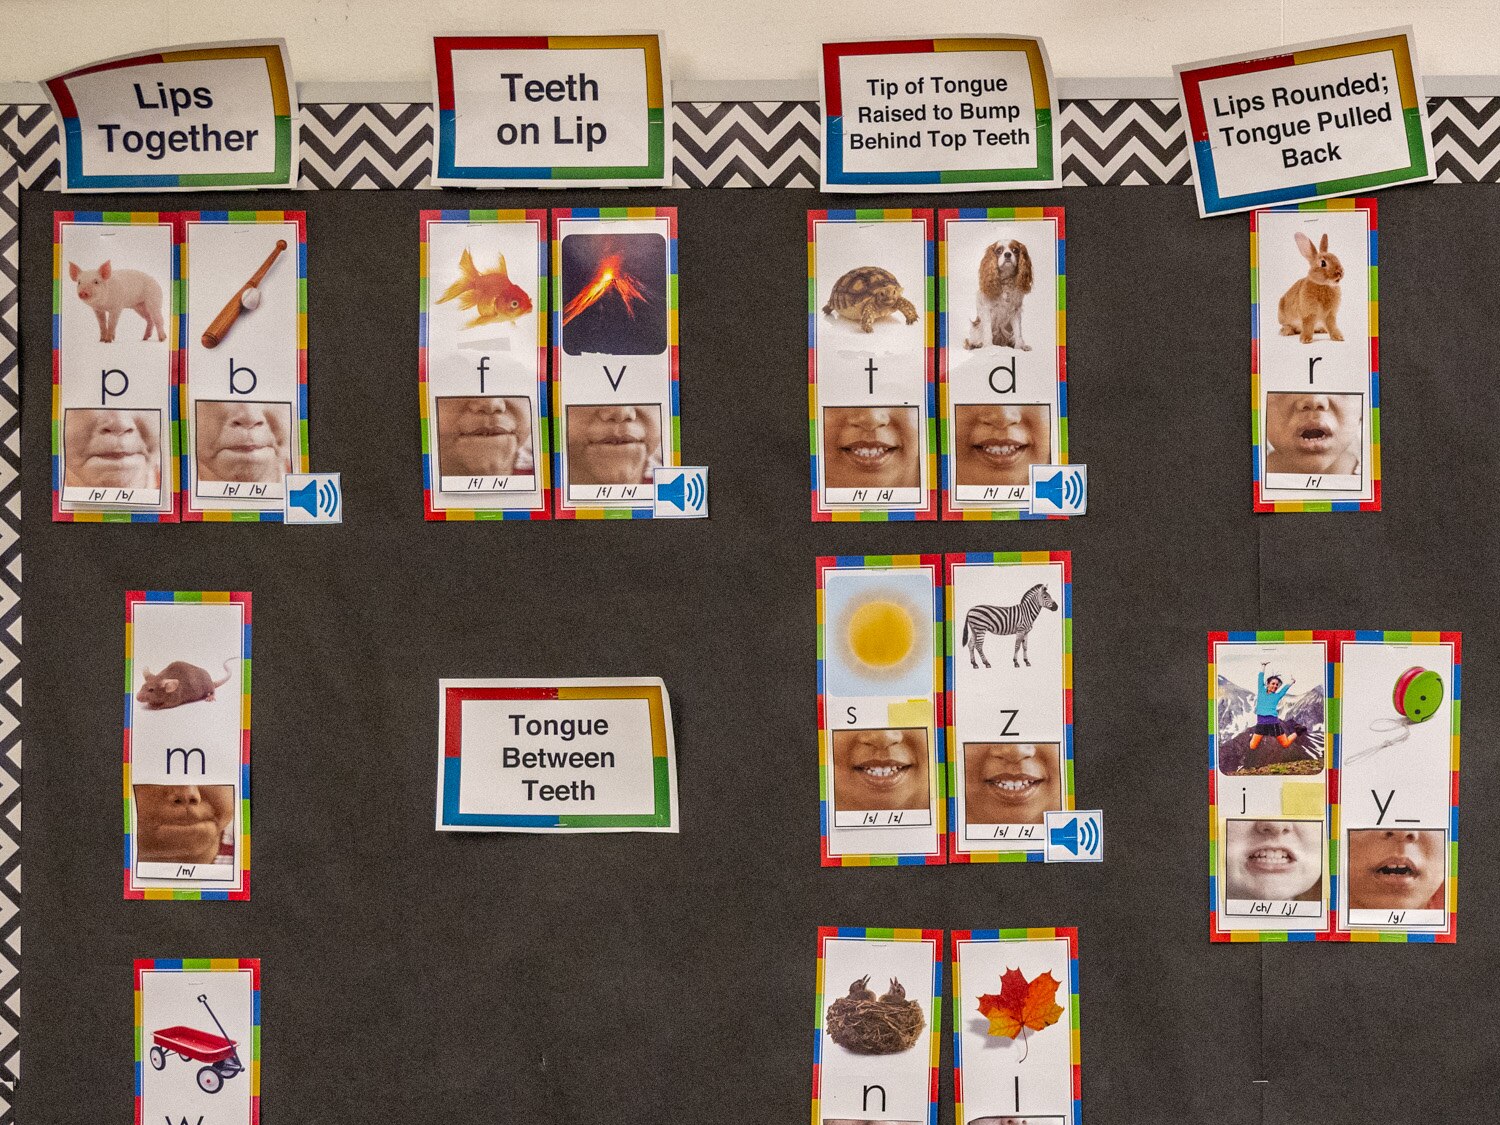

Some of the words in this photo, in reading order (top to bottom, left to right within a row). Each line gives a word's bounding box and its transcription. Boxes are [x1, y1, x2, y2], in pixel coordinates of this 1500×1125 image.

[133, 82, 213, 116] Lips
[501, 73, 598, 102] Teeth
[867, 79, 898, 99] Tip
[905, 77, 924, 94] of
[931, 77, 1007, 97] Tongue
[1213, 95, 1265, 119] Lips
[1272, 72, 1390, 110] Rounded;
[859, 104, 926, 123] Raised
[933, 105, 952, 120] to
[961, 103, 1020, 122] Bump
[1219, 120, 1312, 148] Tongue
[1317, 102, 1391, 131] Pulled
[97, 124, 258, 160] Together
[497, 123, 539, 145] on
[554, 116, 606, 152] Lip
[851, 131, 921, 149] Behind
[927, 131, 966, 151] Top
[973, 128, 1029, 145] Teeth
[1282, 142, 1342, 168] Back
[230, 358, 257, 394] b
[477, 357, 489, 393] f
[603, 366, 626, 391] v
[865, 358, 878, 394] t
[989, 357, 1016, 394] d
[1309, 357, 1322, 384] r
[102, 369, 128, 405] p
[223, 484, 240, 495] /p/
[249, 484, 267, 496] /b/
[468, 478, 483, 489] /f/
[493, 478, 508, 489] /v/
[597, 487, 612, 498] /f/
[621, 487, 637, 498] /v/
[984, 488, 998, 499] /t/
[1008, 488, 1024, 499] /d/
[1306, 476, 1322, 487] /r/
[89, 490, 106, 500] /p/
[116, 490, 134, 501] /b/
[853, 490, 867, 501] /t/
[877, 490, 893, 501] /d/
[509, 715, 608, 741] Tongue
[847, 707, 856, 724] s
[1000, 710, 1019, 736] z
[167, 748, 205, 774] m
[503, 748, 614, 768] Between
[522, 780, 594, 801] Teeth
[1241, 788, 1246, 814] j
[863, 813, 878, 824] /s/
[888, 812, 903, 824] /z/
[994, 826, 1009, 837] /s/
[1018, 826, 1034, 837] /z/
[176, 866, 195, 877] /m/
[1250, 902, 1272, 913] /ch/
[1282, 903, 1297, 914] /j/
[1388, 911, 1405, 923] /y/
[863, 1085, 885, 1112] n
